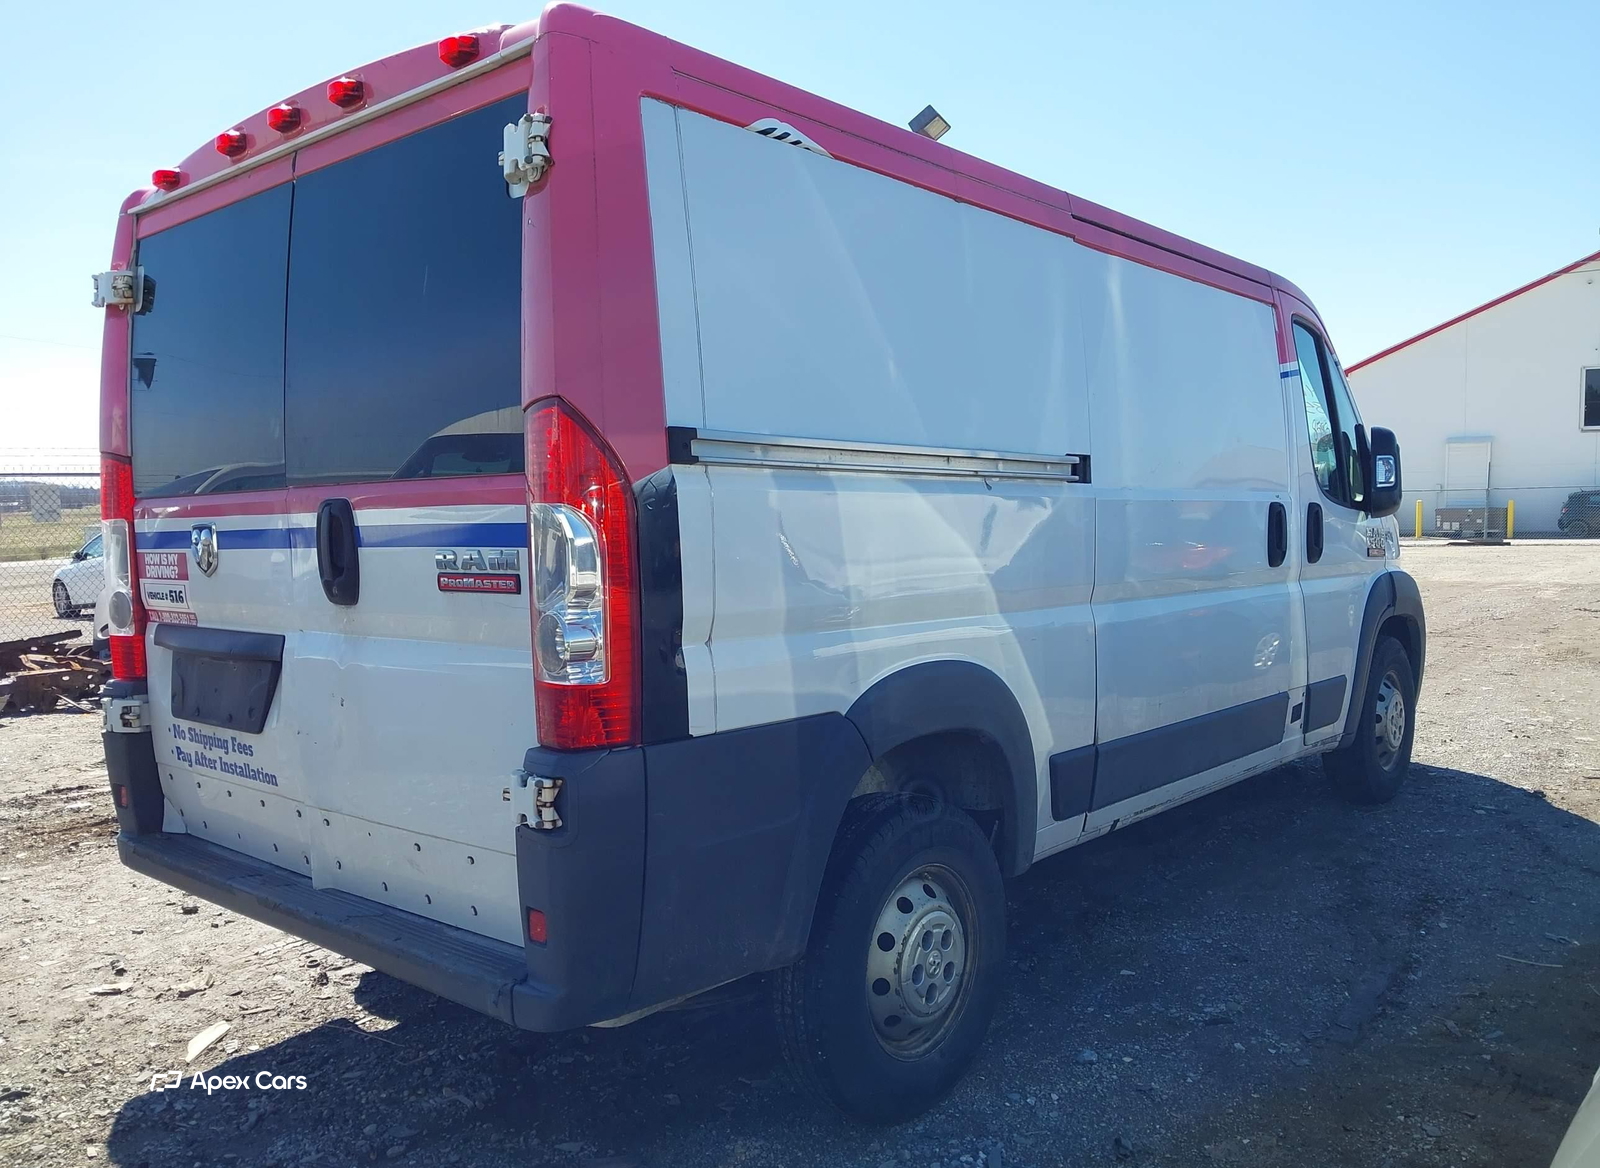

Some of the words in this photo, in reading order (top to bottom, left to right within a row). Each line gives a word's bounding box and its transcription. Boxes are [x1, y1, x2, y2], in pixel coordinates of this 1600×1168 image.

[144, 553, 160, 565] HOW
[160, 554, 168, 565] IS
[167, 554, 178, 566] MY
[434, 549, 520, 571] RAM
[145, 565, 179, 579] DRIVING?
[147, 591, 165, 601] VEHICLE
[168, 589, 185, 604] 516
[172, 723, 187, 740] No
[187, 726, 230, 755] Shipping
[230, 736, 254, 757] Fees
[175, 746, 193, 768] Pay
[194, 750, 218, 771] After
[218, 756, 279, 787] Installation
